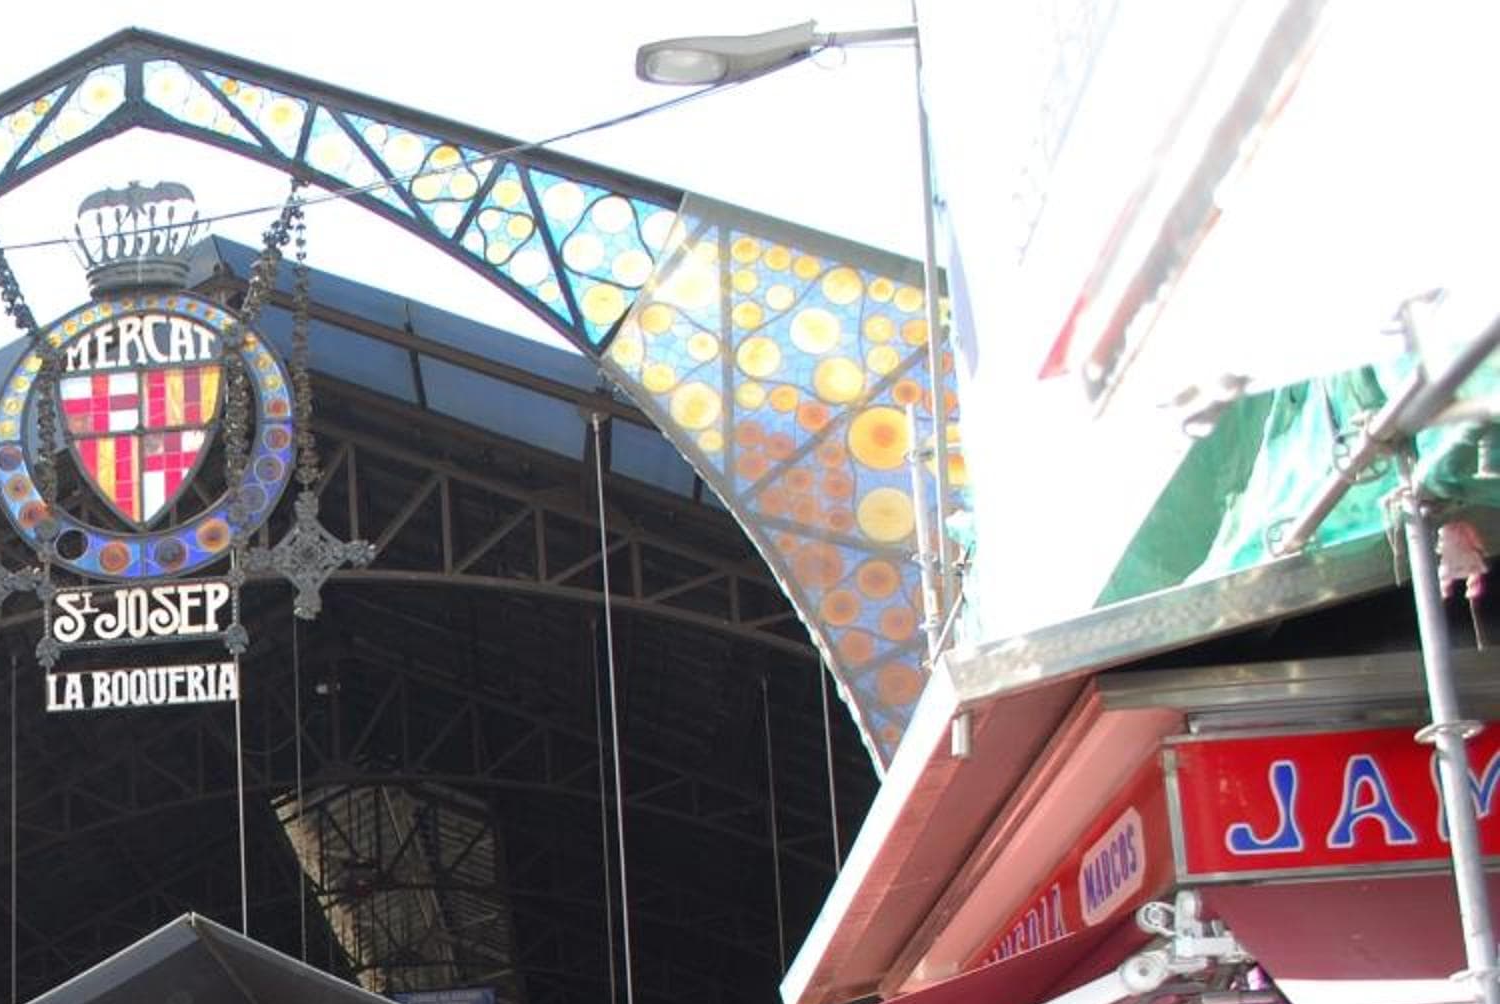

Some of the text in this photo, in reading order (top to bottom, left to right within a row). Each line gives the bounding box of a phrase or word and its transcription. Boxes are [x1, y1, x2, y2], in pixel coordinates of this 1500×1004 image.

[65, 314, 216, 372] MERCAT
[94, 582, 230, 640] JOSEP
[46, 661, 240, 712] LA BOQUERIA
[1083, 823, 1138, 914] MARCOS
